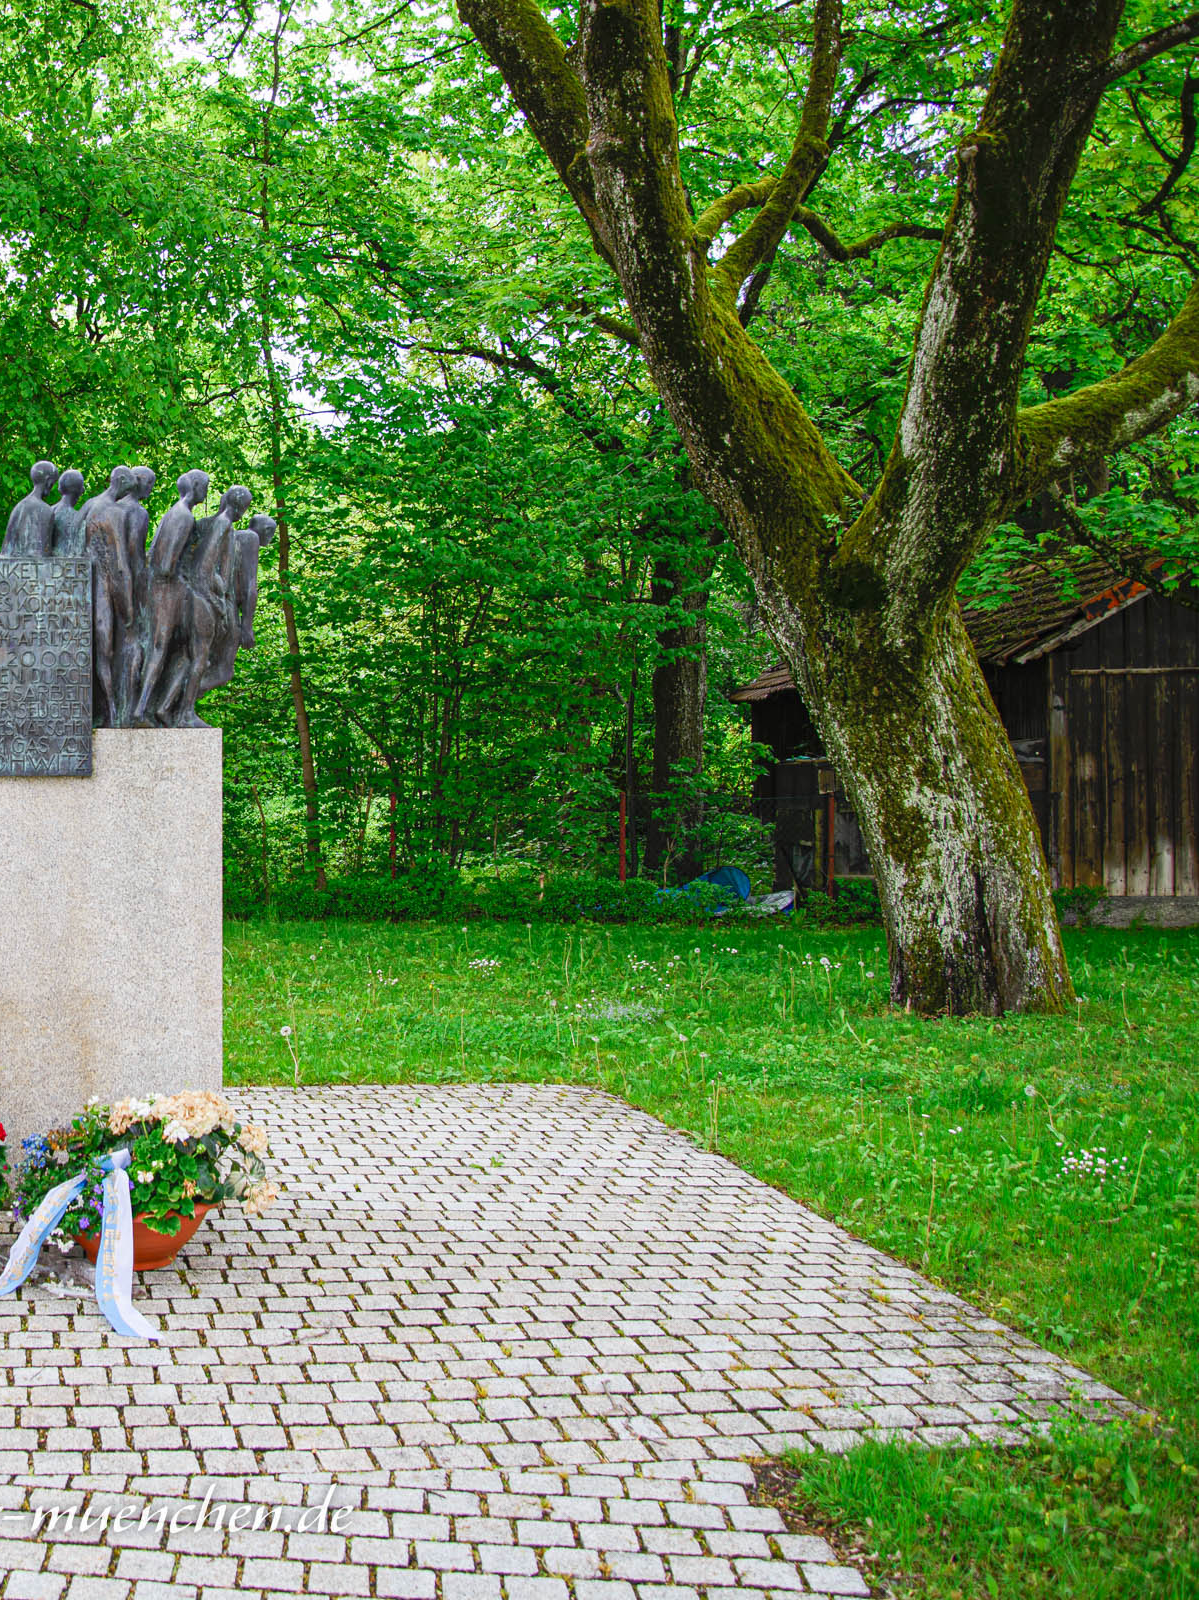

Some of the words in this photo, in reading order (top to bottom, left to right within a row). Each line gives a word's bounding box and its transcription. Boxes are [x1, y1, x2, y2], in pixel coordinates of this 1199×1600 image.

[50, 562, 89, 580] DER
[6, 650, 91, 668] 20000
[31, 668, 91, 685] DURCH
[15, 701, 91, 719] SEUCHEN
[10, 736, 50, 754] GAS
[58, 736, 91, 754] VON
